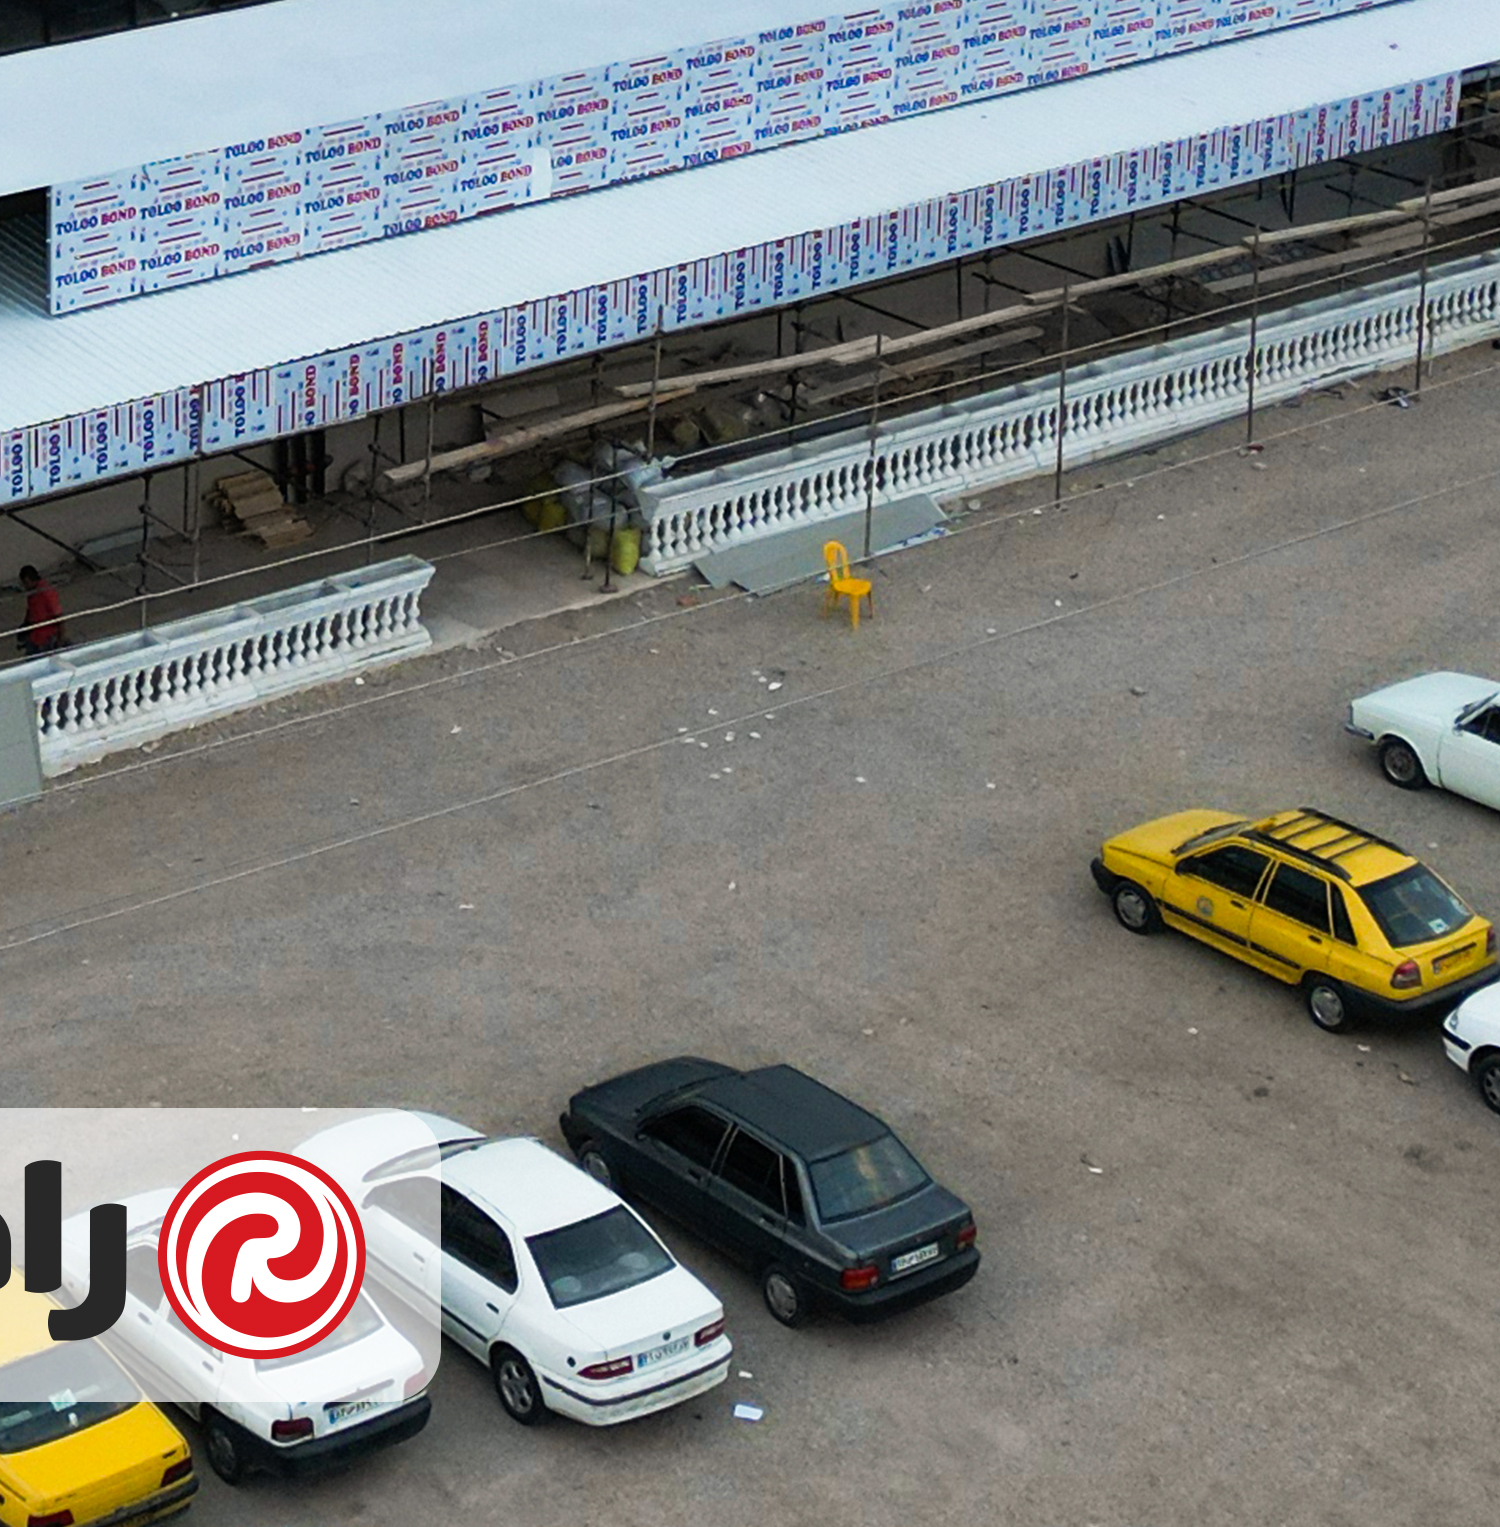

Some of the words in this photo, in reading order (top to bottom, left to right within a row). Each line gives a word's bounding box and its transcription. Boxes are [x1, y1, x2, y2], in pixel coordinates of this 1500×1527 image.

[223, 139, 266, 160] TOLOO
[550, 154, 574, 171] LOO
[139, 199, 183, 221] TOLOO
[223, 190, 265, 211] TOLOO
[54, 215, 99, 237] TOLOO
[139, 250, 183, 272] TOLOO
[223, 240, 265, 261] TOLOO
[55, 266, 99, 288] TOLOO
